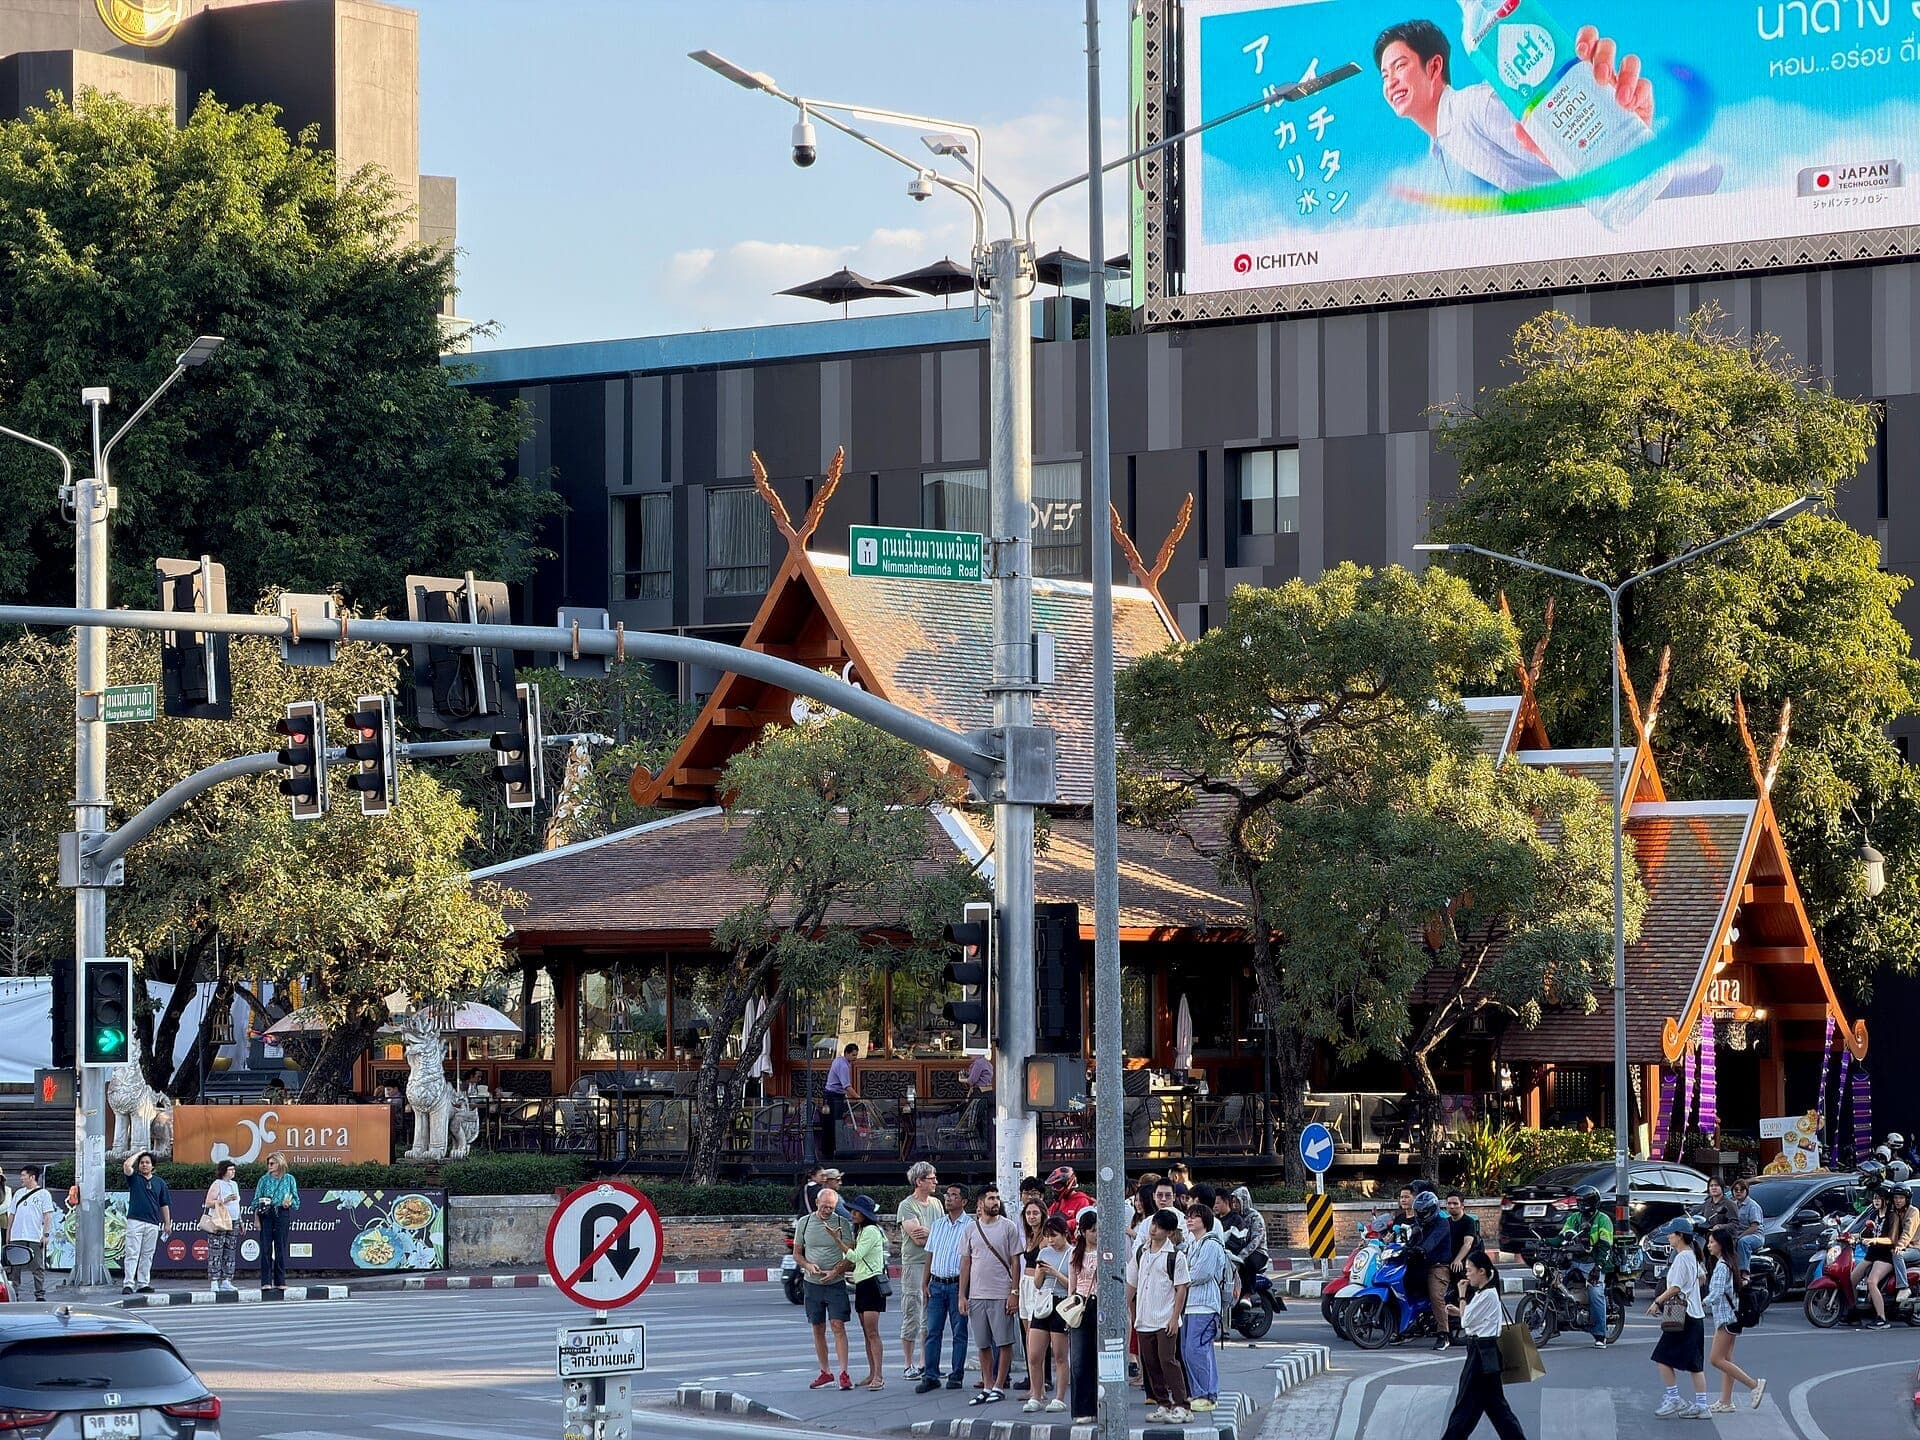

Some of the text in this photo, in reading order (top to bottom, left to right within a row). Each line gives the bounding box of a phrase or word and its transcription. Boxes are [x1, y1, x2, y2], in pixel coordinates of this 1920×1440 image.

[1525, 51, 1544, 71] PLUS
[1838, 163, 1889, 181] JAPAN
[1838, 177, 1890, 190] TECHNOLOGY
[1255, 250, 1319, 271] ICHITAN
[882, 531, 980, 562] ถนนนิมมานเหมินท์
[882, 559, 979, 578] Nimmanhaeminda Road
[106, 688, 152, 708] ถนนห้วยแก้ว
[136, 707, 152, 717] Road
[286, 1126, 349, 1148] nara
[293, 1154, 342, 1164] thai cuisine
[587, 1332, 618, 1346] ยกเว้น
[114, 1415, 134, 1427] 664
